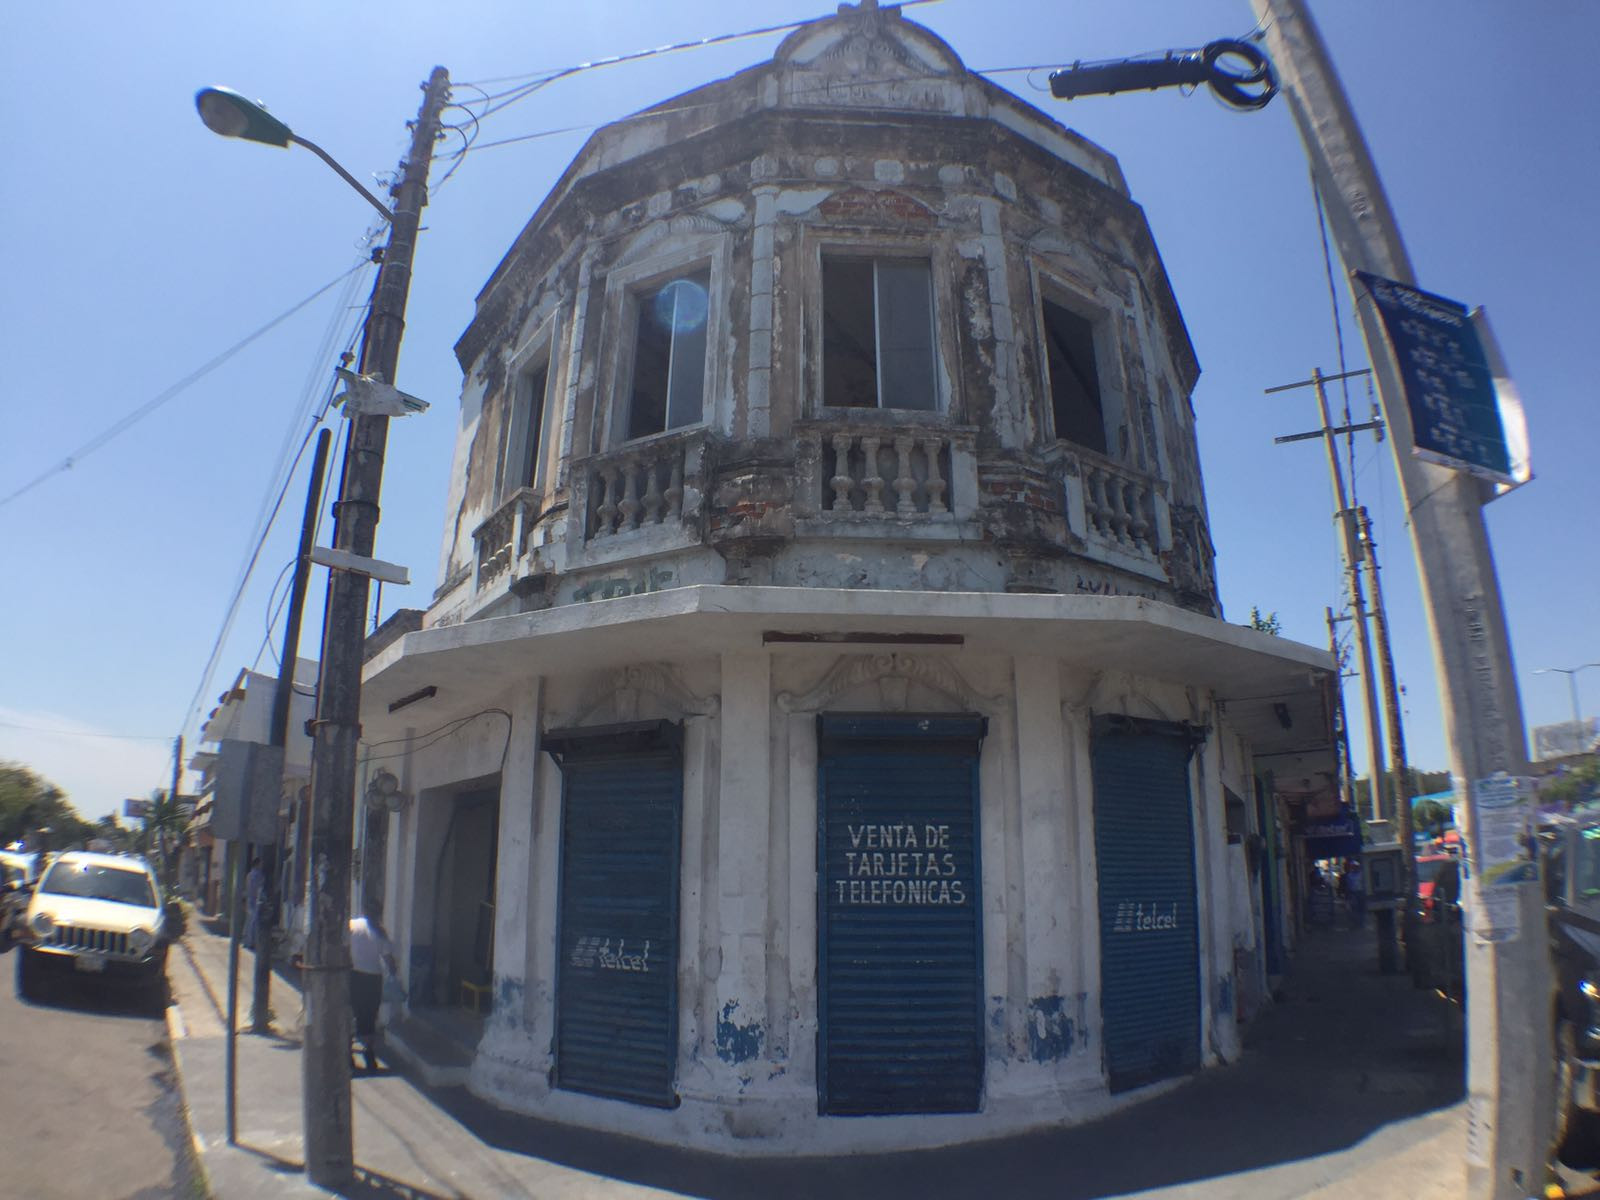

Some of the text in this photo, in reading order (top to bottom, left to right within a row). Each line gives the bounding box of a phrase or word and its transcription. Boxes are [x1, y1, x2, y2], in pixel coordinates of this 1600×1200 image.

[847, 824, 950, 849] VENTA DE
[845, 852, 957, 877] TARJETAS
[835, 880, 966, 905] TELEFONICAS
[1136, 902, 1177, 931] telcel
[599, 938, 650, 972] telcel
